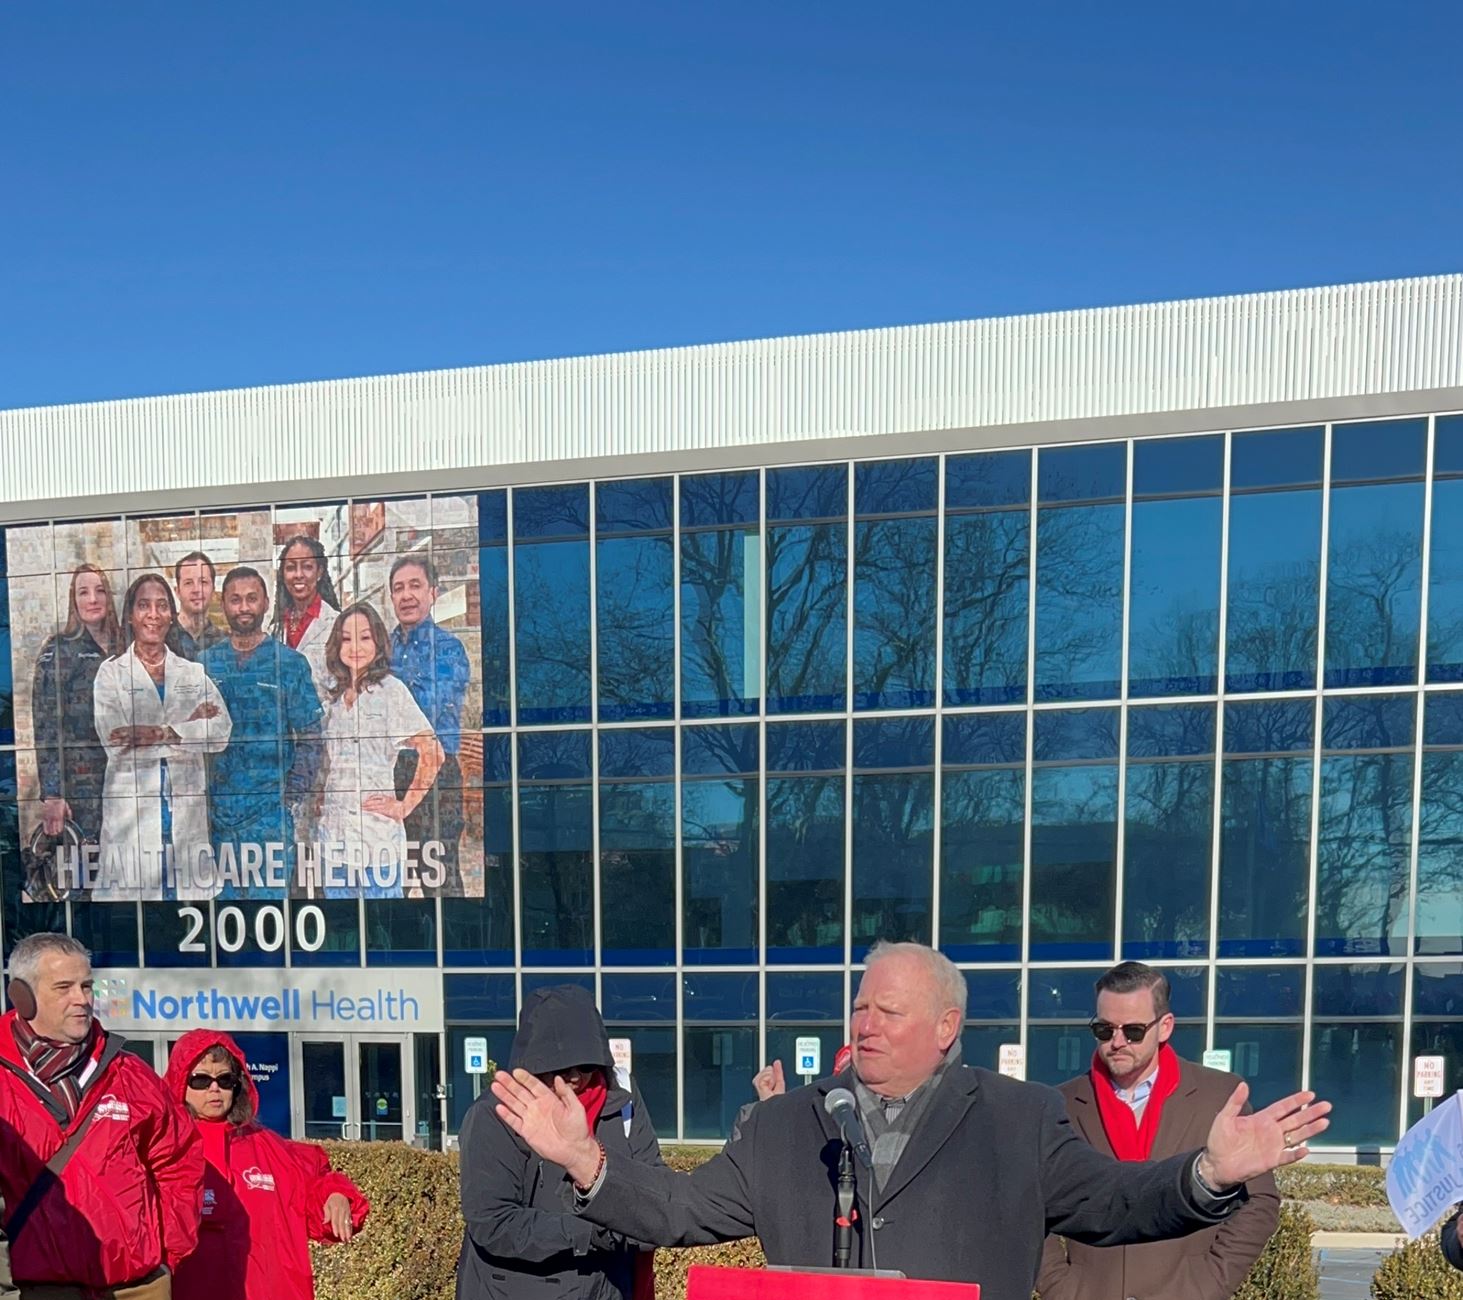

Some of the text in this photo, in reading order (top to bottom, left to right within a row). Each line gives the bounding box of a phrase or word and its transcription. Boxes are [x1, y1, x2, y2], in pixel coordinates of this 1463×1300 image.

[57, 840, 447, 889] HEALTHCARE HEROES
[178, 905, 326, 953] 2000
[133, 988, 419, 1021] Northwell Health
[1416, 1071, 1441, 1079] PARKING
[1424, 1062, 1435, 1070] NO
